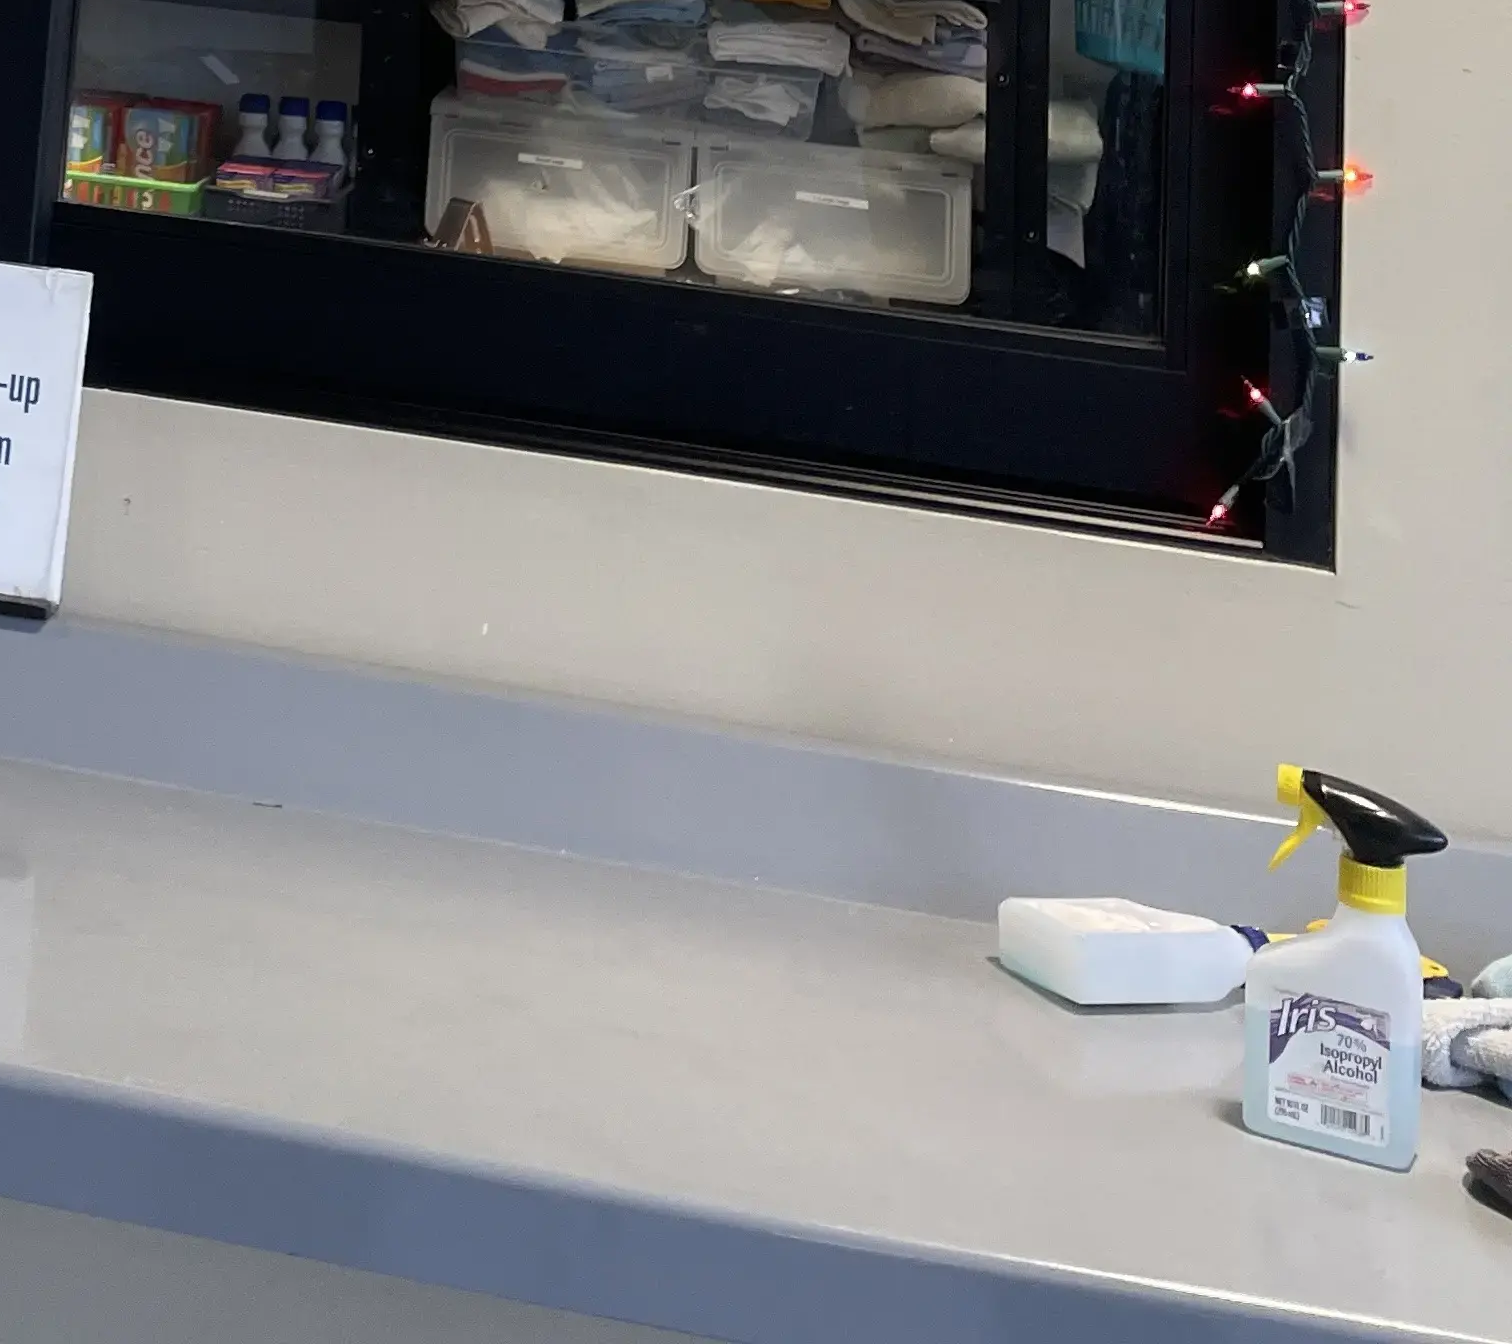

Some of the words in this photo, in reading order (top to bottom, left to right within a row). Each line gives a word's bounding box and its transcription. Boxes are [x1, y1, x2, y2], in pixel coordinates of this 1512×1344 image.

[1278, 999, 1336, 1036] Iris
[1337, 1033, 1367, 1053] 70%
[1320, 1043, 1382, 1071] Isopropyl
[1323, 1060, 1378, 1084] Alcohol
